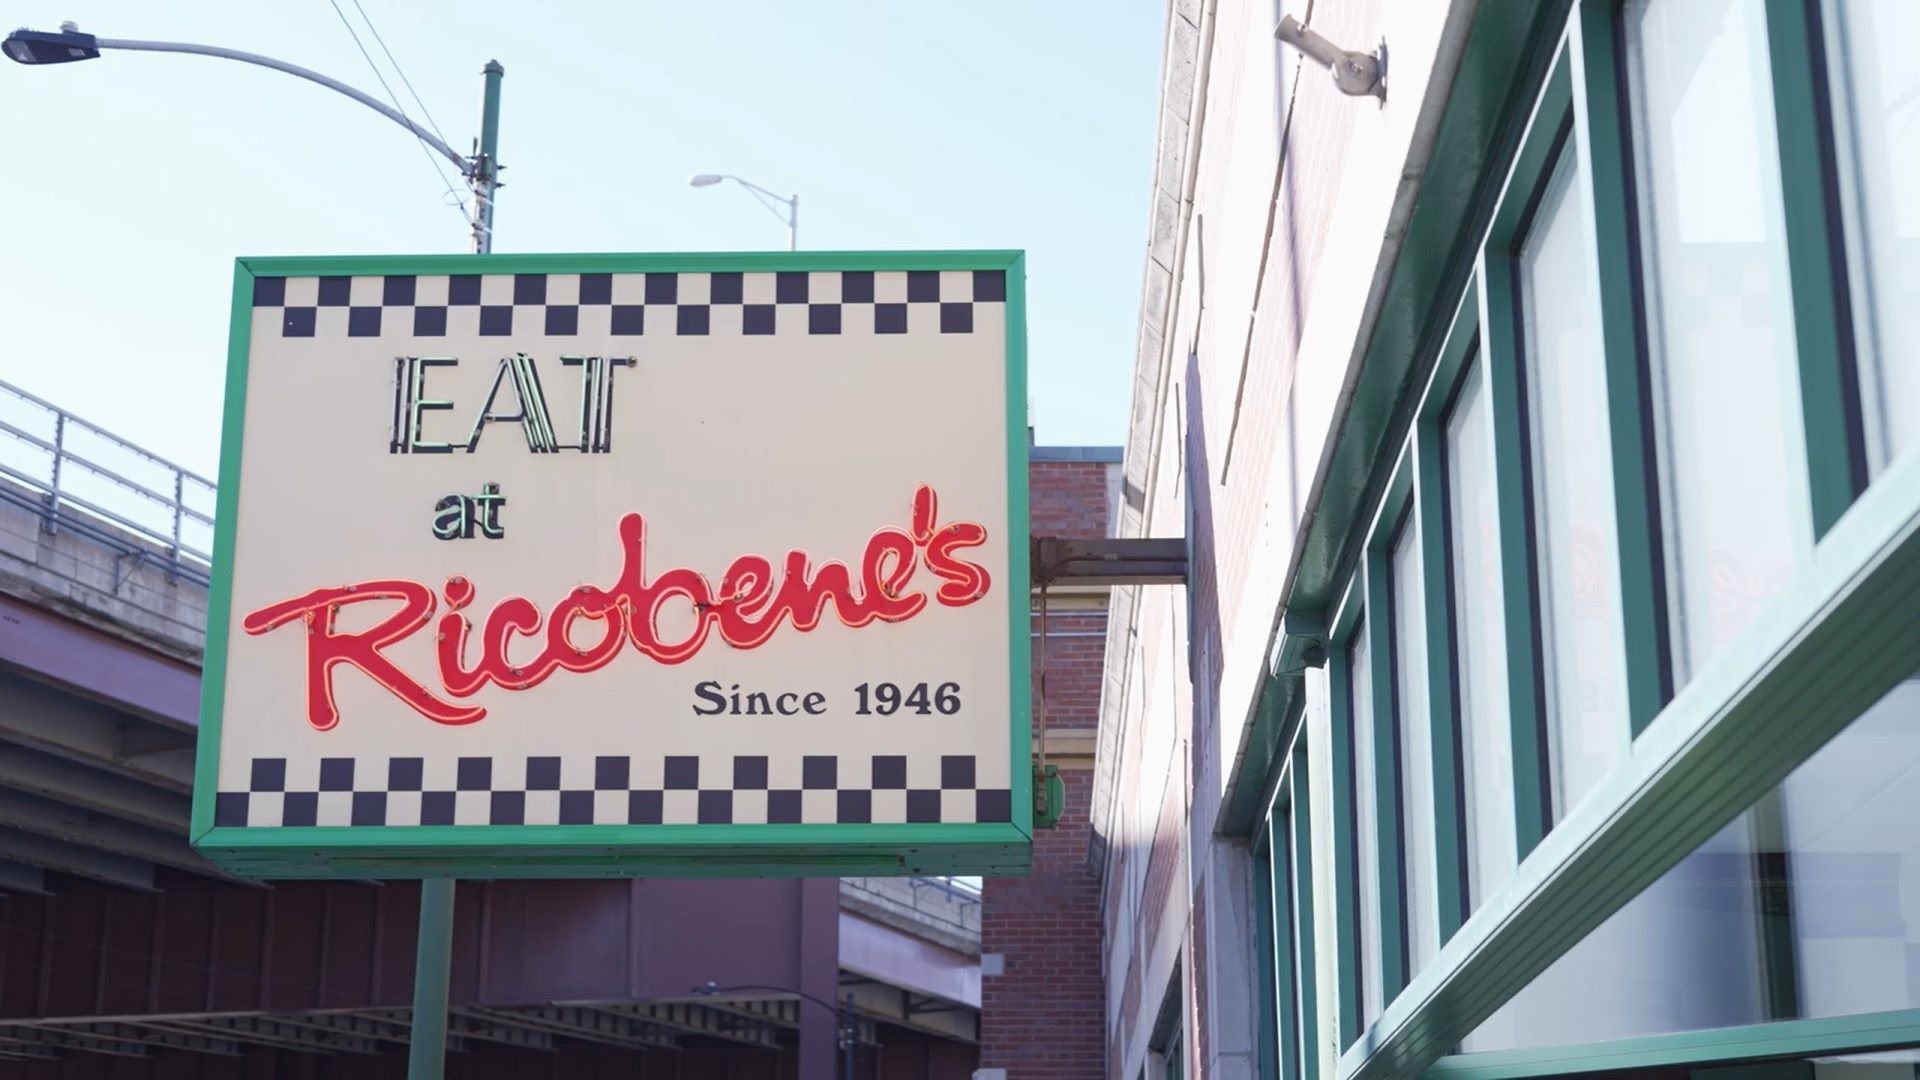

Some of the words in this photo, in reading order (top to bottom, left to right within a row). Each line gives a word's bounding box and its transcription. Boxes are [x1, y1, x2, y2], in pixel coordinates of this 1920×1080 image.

[390, 353, 637, 454] EAT
[432, 483, 506, 540] at
[243, 484, 991, 732] Ricobene's
[693, 681, 827, 715] Since
[855, 682, 961, 716] 1946
